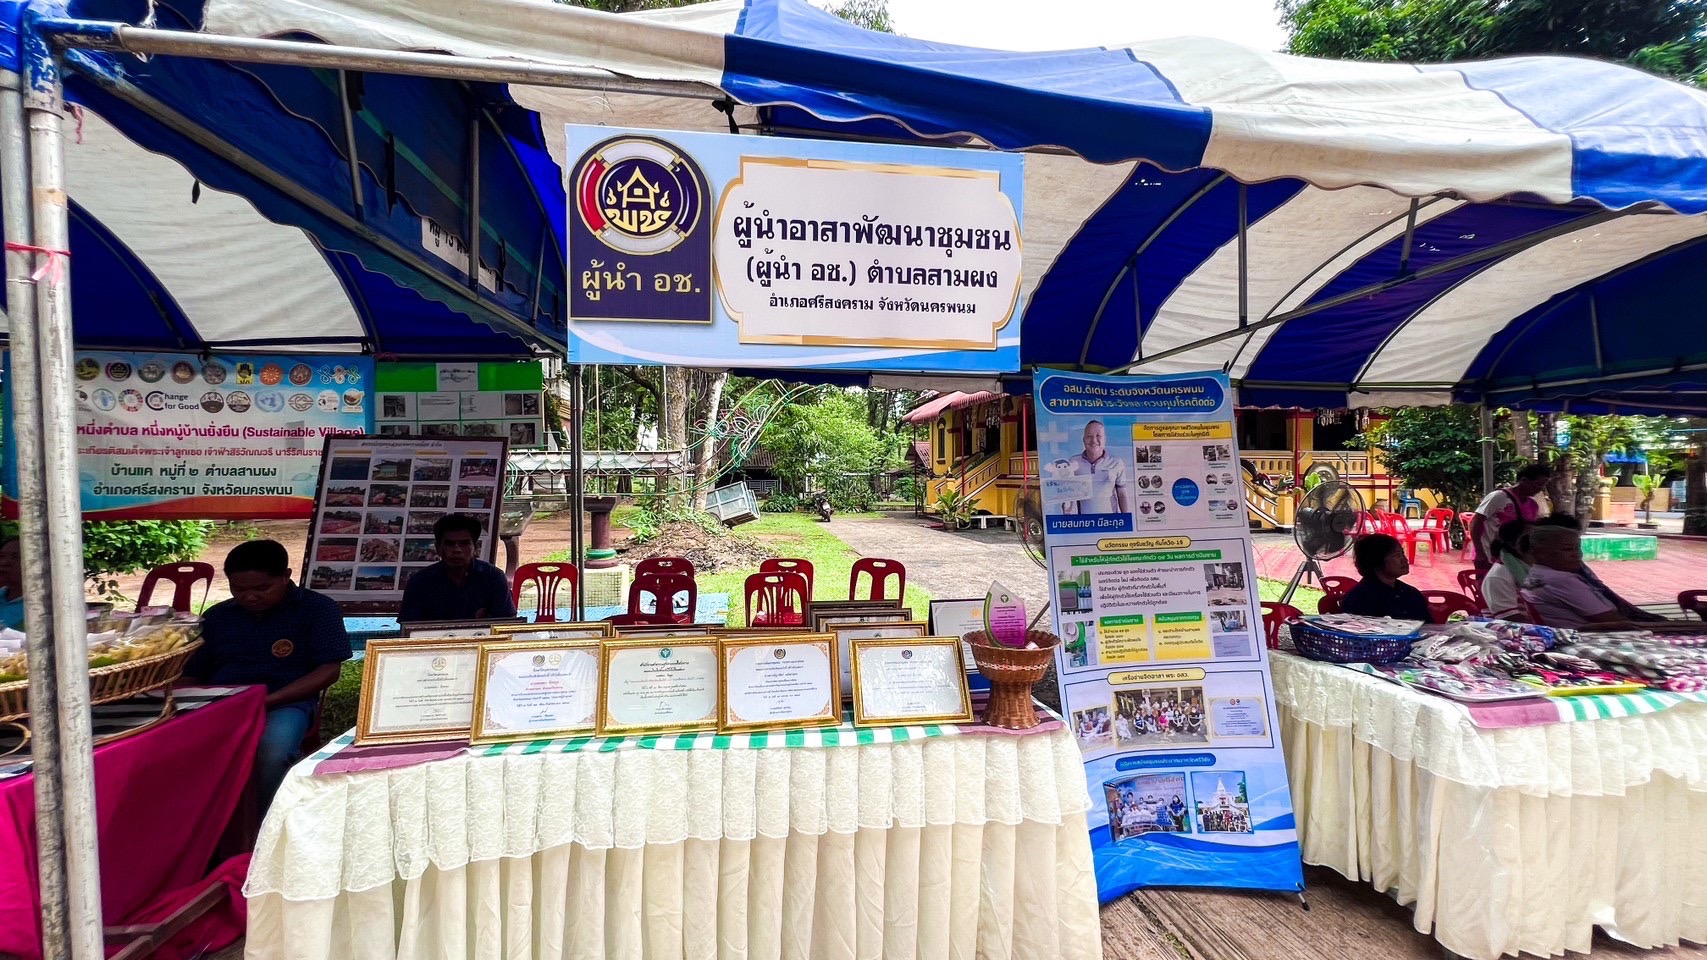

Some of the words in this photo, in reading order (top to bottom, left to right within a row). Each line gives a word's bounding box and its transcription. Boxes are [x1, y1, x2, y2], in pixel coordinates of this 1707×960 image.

[732, 200, 1012, 258] ผู้นำอาสาพัฒนาชุมชน
[582, 259, 642, 301] ผู้นำ
[654, 268, 701, 295] อช.
[746, 248, 801, 290] (ผู้นำ
[810, 260, 857, 286] อช.)
[867, 258, 999, 288] ตำบลสามผง
[769, 293, 874, 312] อำเภอศรีสงคราม
[878, 296, 977, 315] จังหวัดนครพนม
[164, 402, 177, 410] for
[178, 402, 200, 410] Good
[76, 419, 139, 437] หนึ่งตำบล
[141, 419, 240, 441] หนึ่งหมู่บ้านยั่งยืน
[242, 426, 316, 440] (Sustainable
[111, 462, 153, 477] บ้านแค
[159, 460, 186, 480] หมู่ที่
[189, 467, 199, 477] ๒
[205, 463, 277, 477] ตำบลสามผง
[93, 482, 196, 496] อำเภอศรีสงคราม
[202, 482, 293, 496] จังหวัดนครพนม
